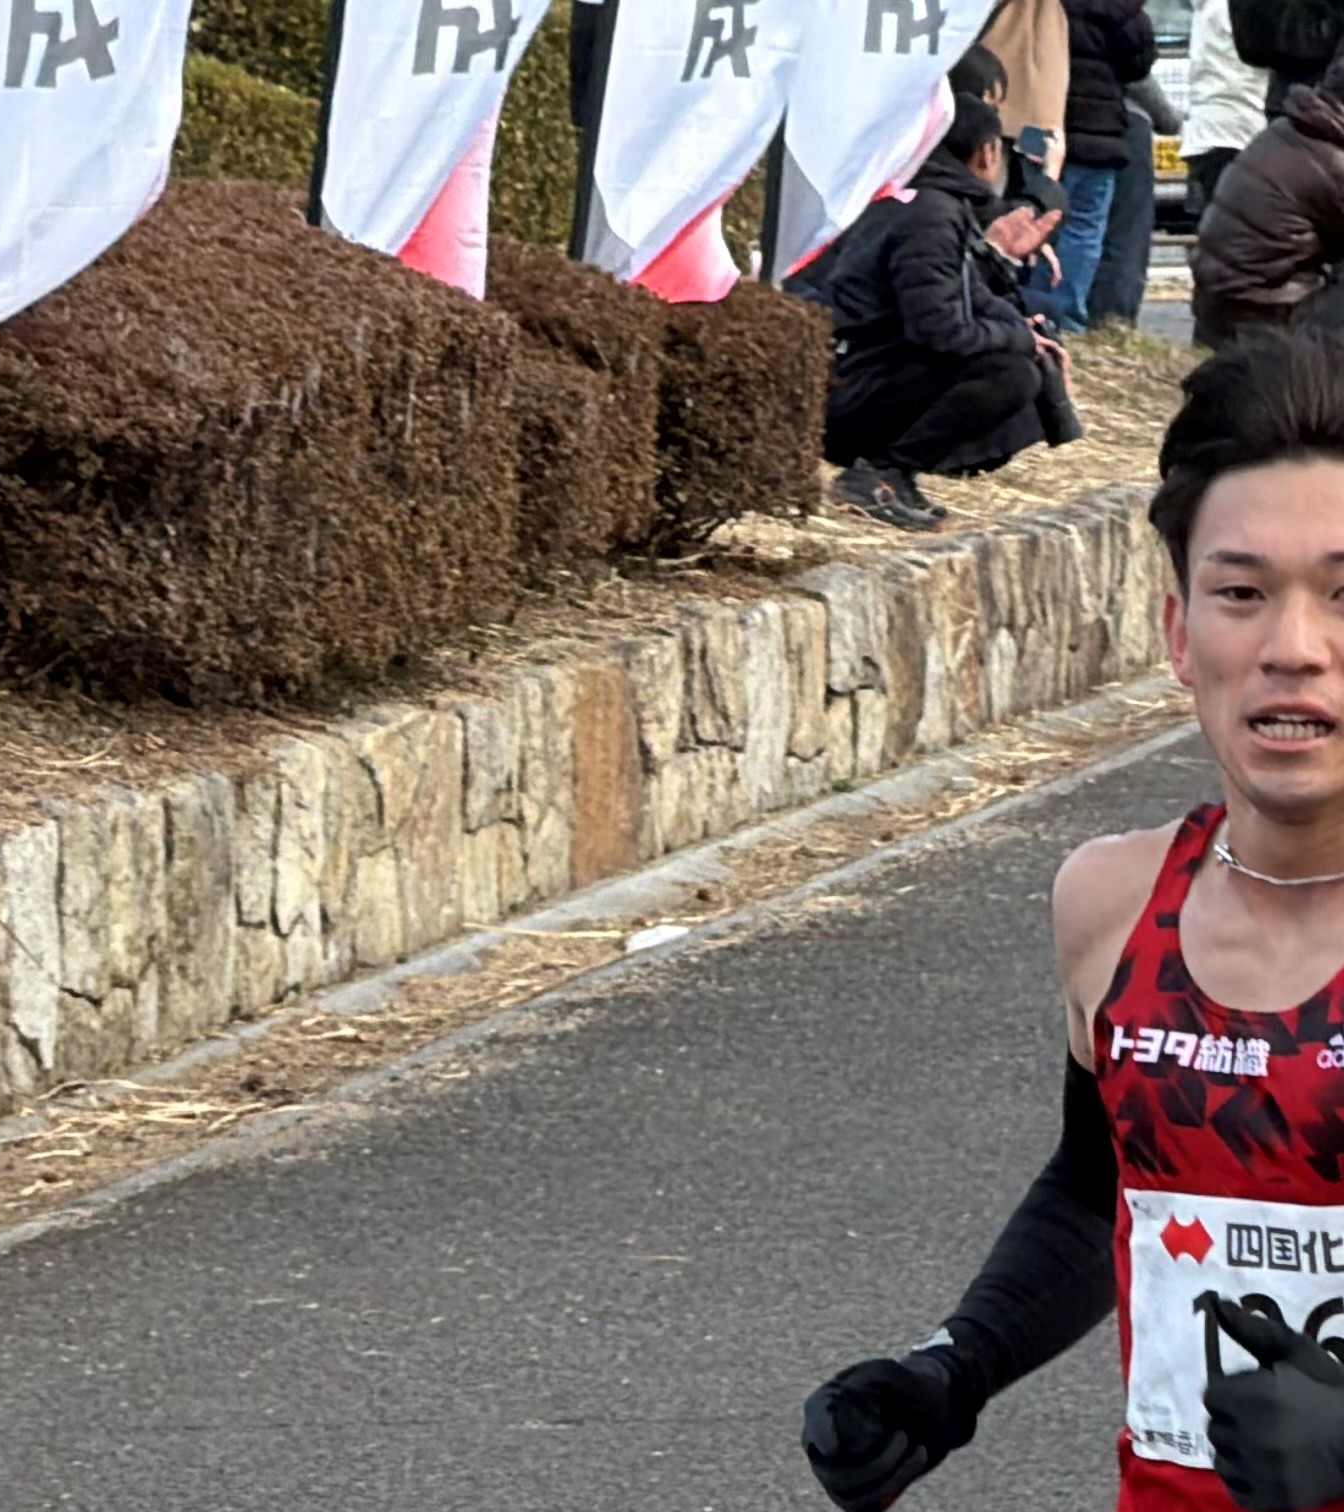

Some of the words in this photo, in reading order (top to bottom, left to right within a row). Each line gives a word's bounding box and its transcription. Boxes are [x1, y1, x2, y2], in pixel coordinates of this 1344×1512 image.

[1111, 1025, 1271, 1077] トヨタ紡織
